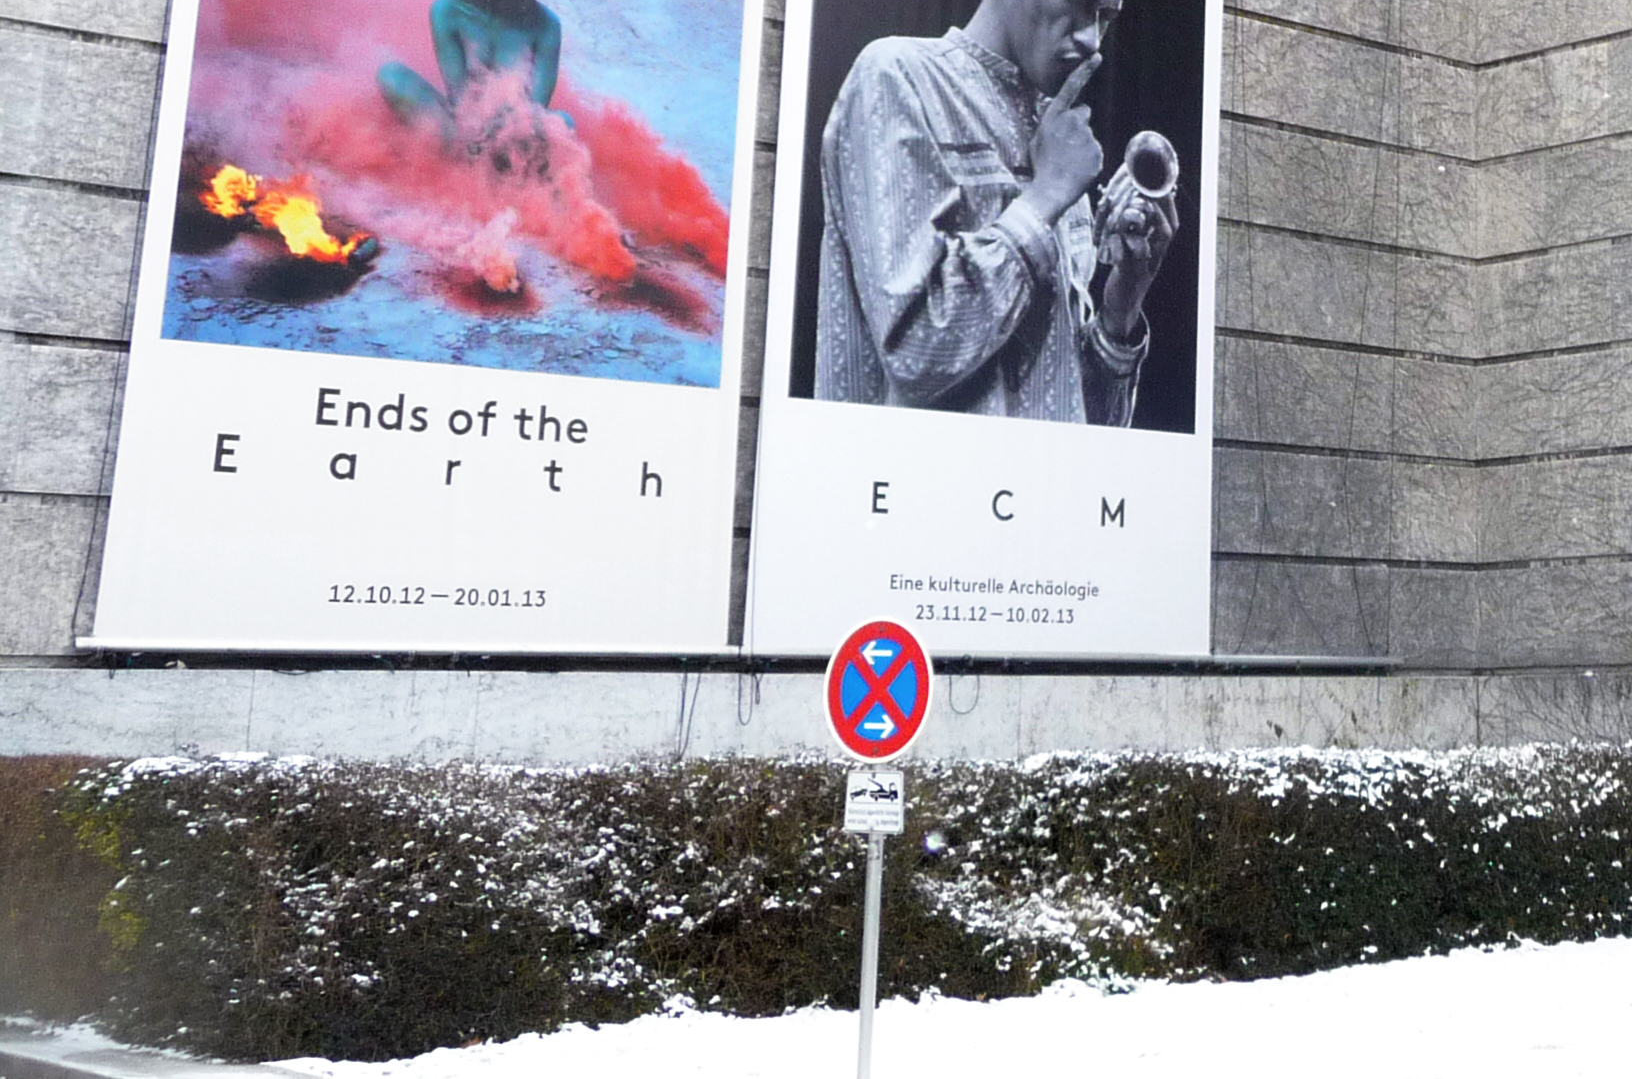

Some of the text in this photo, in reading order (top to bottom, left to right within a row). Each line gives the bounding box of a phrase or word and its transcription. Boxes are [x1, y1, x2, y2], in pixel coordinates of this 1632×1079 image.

[315, 387, 589, 444] Ends of the
[213, 433, 663, 498] Earth
[871, 481, 1126, 528] ECM
[890, 574, 1100, 601] Eine kulturelle Archäologie
